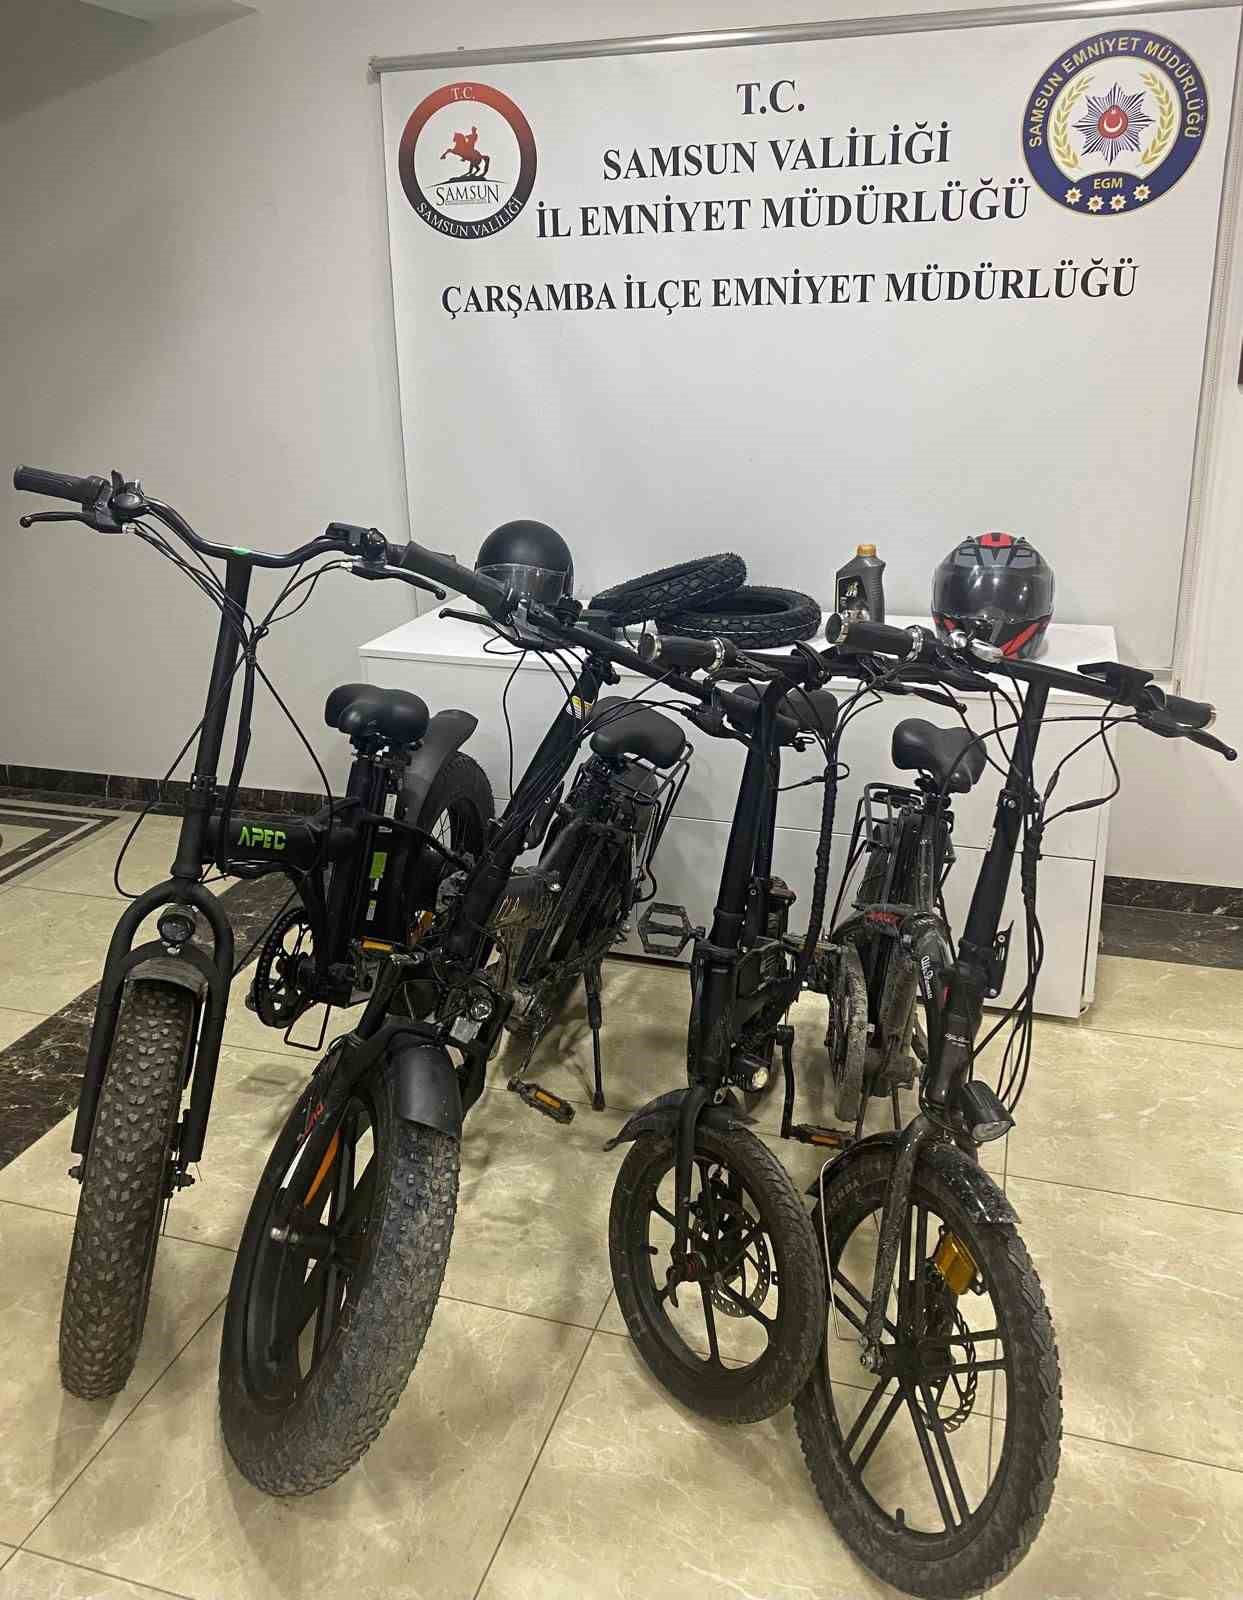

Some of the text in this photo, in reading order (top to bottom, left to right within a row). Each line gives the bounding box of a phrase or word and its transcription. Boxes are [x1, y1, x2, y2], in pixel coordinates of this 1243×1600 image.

[450, 86, 476, 101] T.C.
[736, 79, 806, 115] T.C.
[1028, 71, 1064, 149] SAMSUN
[1061, 36, 1142, 74] EMNİYET
[603, 120, 951, 181] SAMSUN VALİLİĞİ
[435, 184, 500, 207] SAMSUN
[1093, 177, 1123, 189] EGM
[416, 201, 470, 237] SAMSUN
[535, 177, 1032, 238] İL EMNİYET MÜDÜRLÜĞÜ
[441, 257, 1139, 321] ÇARŞAMBA İLÇE EMNİYET MÜDÜRLÜĞÜ
[237, 826, 286, 850] APEC
